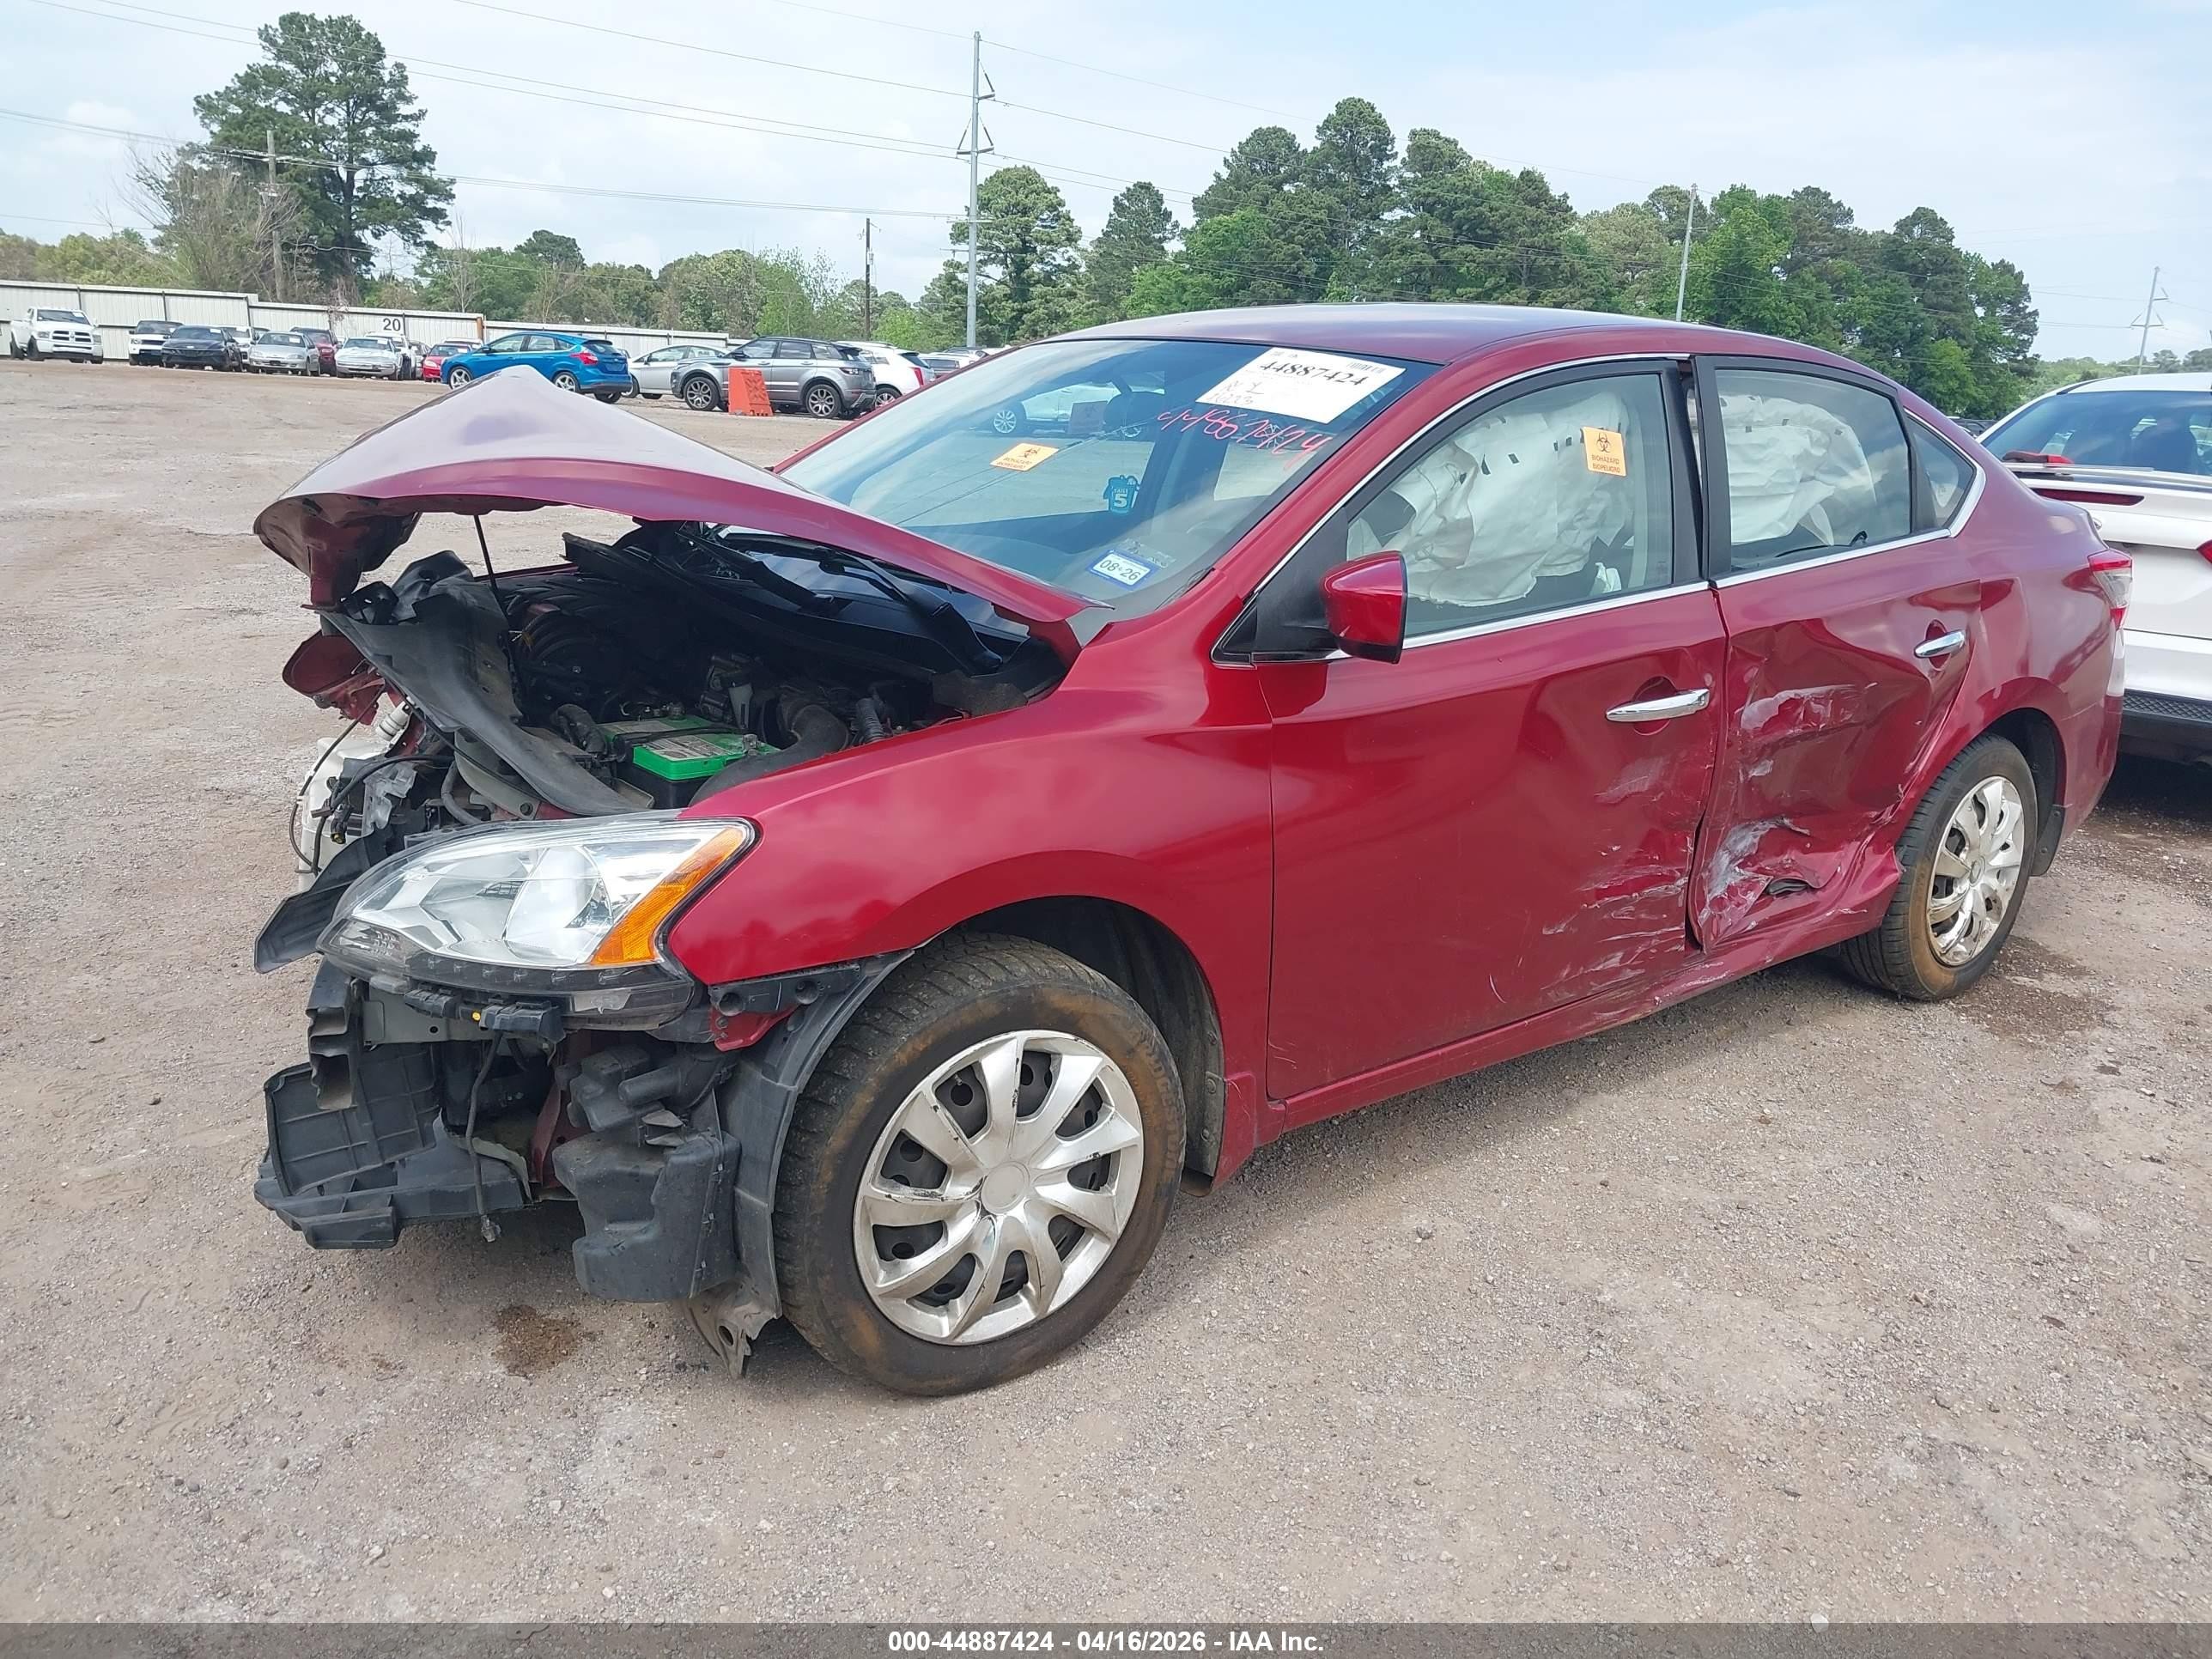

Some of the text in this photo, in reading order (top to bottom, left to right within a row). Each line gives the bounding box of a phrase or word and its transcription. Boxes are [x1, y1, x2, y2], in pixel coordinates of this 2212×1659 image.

[383, 318, 401, 331] 20
[1260, 361, 1369, 386] 44887424
[1158, 408, 1333, 469] 44887424
[1591, 454, 1620, 465] BIOHAZARD
[1114, 493, 1127, 507] 5
[1100, 559, 1120, 571] 08
[1120, 568, 1141, 580] 26
